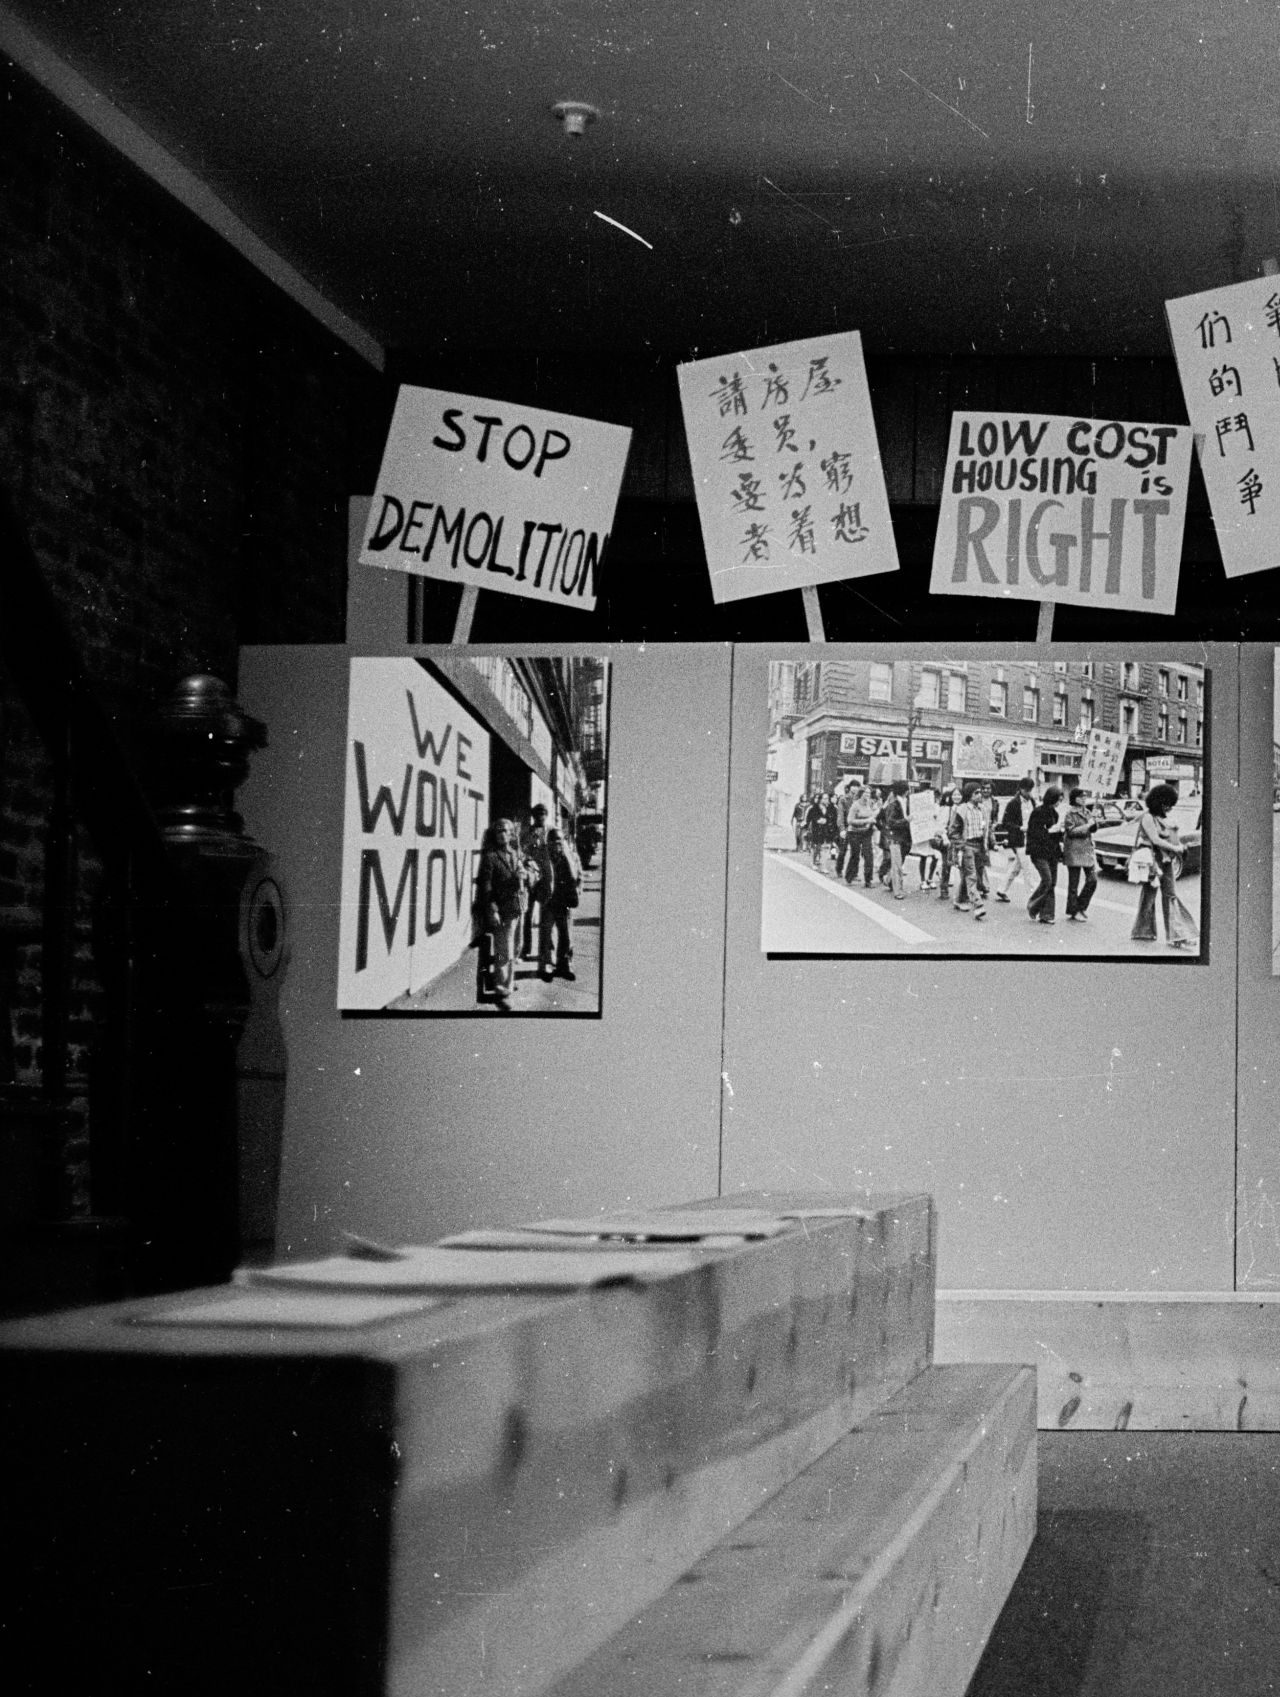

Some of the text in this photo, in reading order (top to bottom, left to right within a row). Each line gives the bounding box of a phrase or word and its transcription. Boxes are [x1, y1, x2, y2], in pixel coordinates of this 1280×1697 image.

[433, 408, 571, 478] STOP
[958, 420, 1178, 469] LOW COST
[1140, 469, 1174, 497] is
[367, 495, 611, 598] DEMOLITION
[951, 495, 1171, 600] RIGHT
[405, 688, 473, 782] WE
[860, 738, 924, 757] SALE
[353, 738, 485, 841] WON'T
